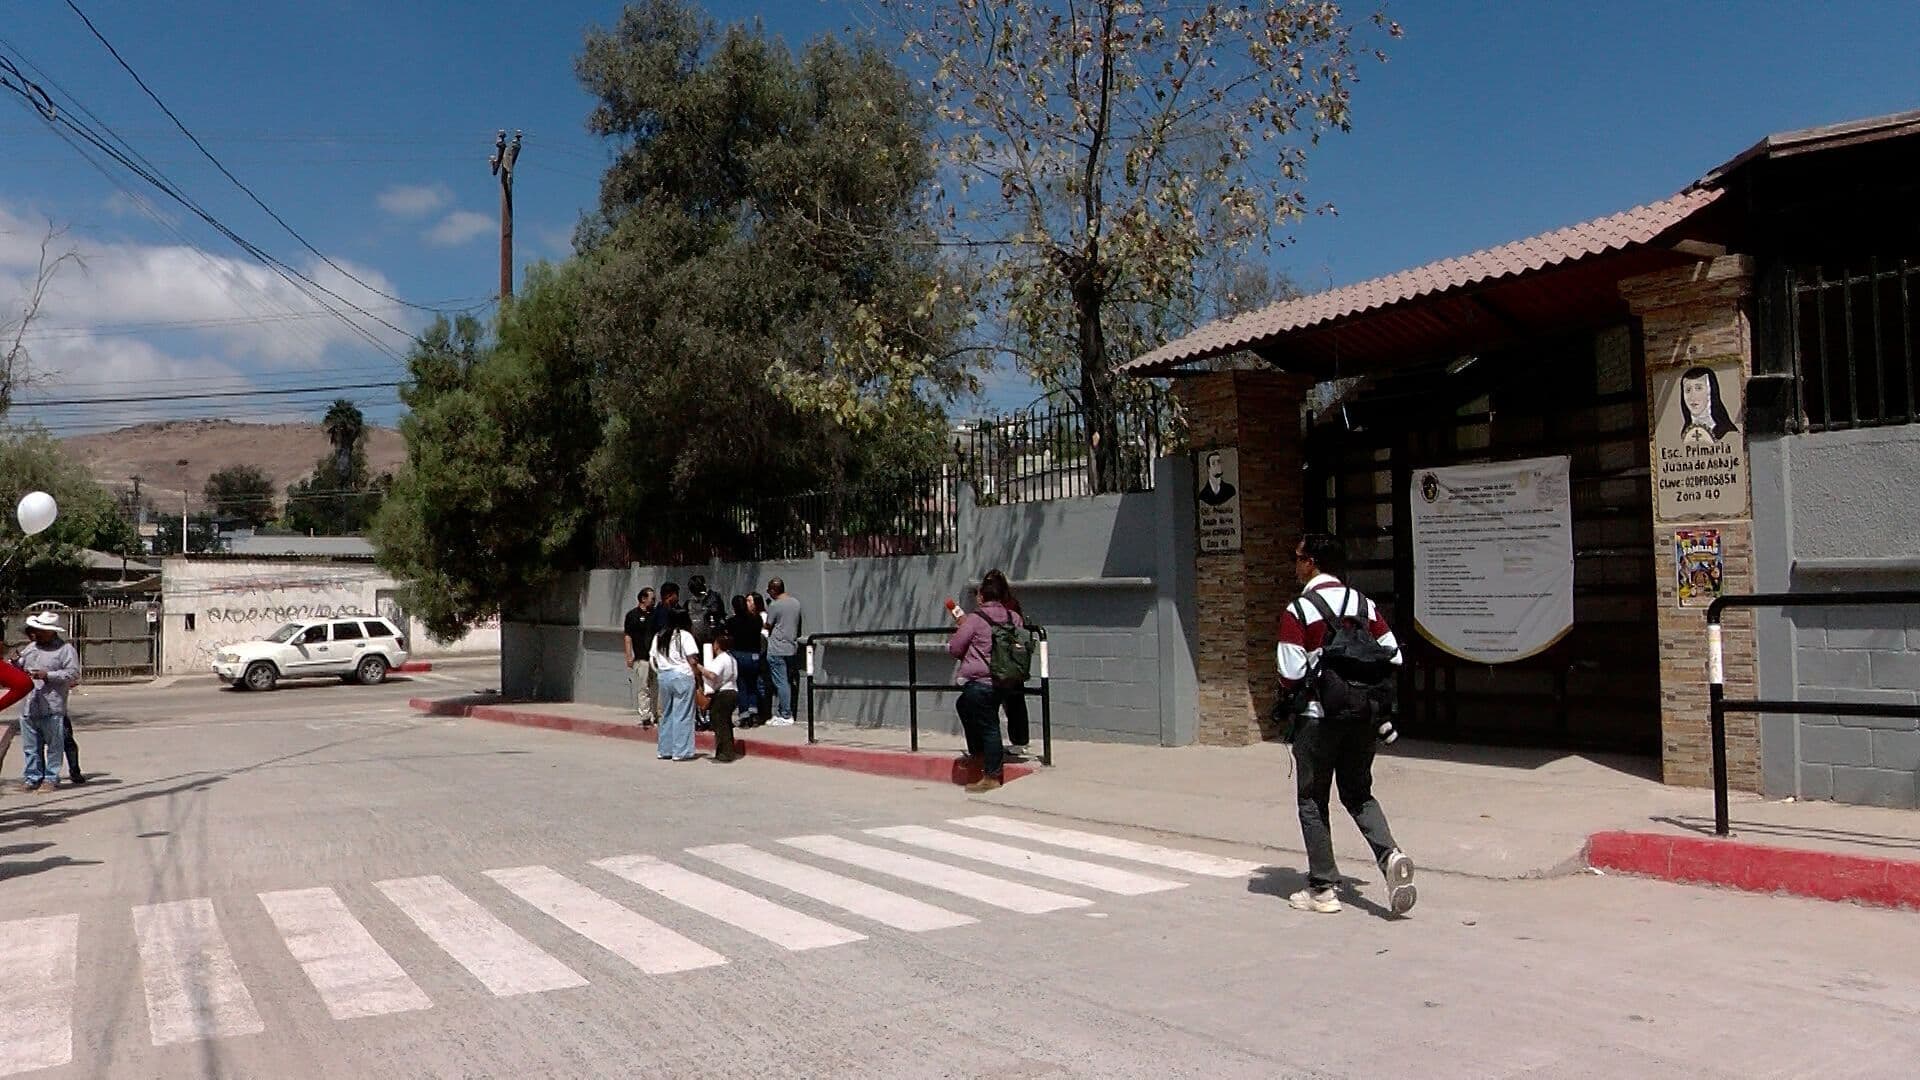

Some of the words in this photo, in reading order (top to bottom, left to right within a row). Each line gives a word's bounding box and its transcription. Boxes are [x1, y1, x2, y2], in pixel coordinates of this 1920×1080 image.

[1661, 447, 1682, 460] Esc.
[1685, 442, 1731, 457] Primaria
[1662, 462, 1693, 473] Juana
[1694, 460, 1705, 470] de
[1676, 491, 1701, 502] Zona
[1705, 489, 1720, 500] 40
